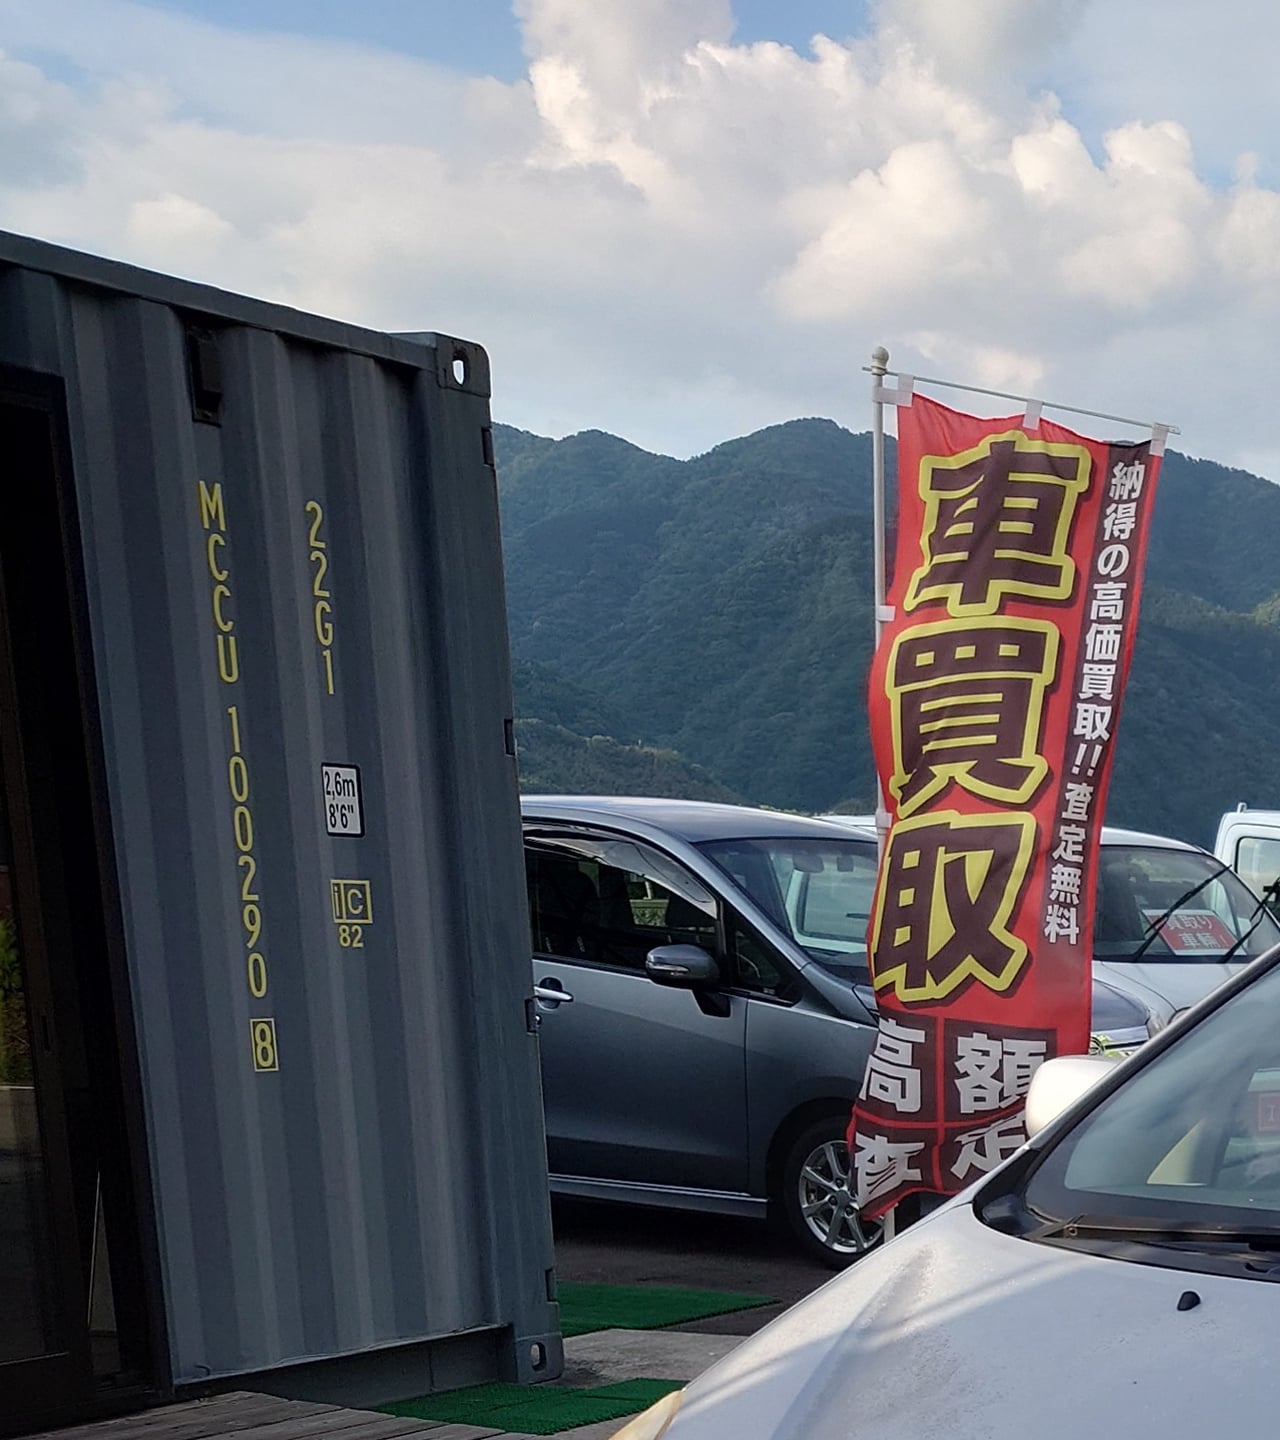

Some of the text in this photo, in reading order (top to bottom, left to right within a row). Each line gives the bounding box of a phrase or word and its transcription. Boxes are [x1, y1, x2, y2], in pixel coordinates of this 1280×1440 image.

[305, 500, 336, 696] 22G1
[199, 480, 275, 1068] MCCU 100290 8
[324, 771, 356, 800] 2,6m
[872, 430, 1091, 1002] 車買取
[338, 924, 364, 948] 82
